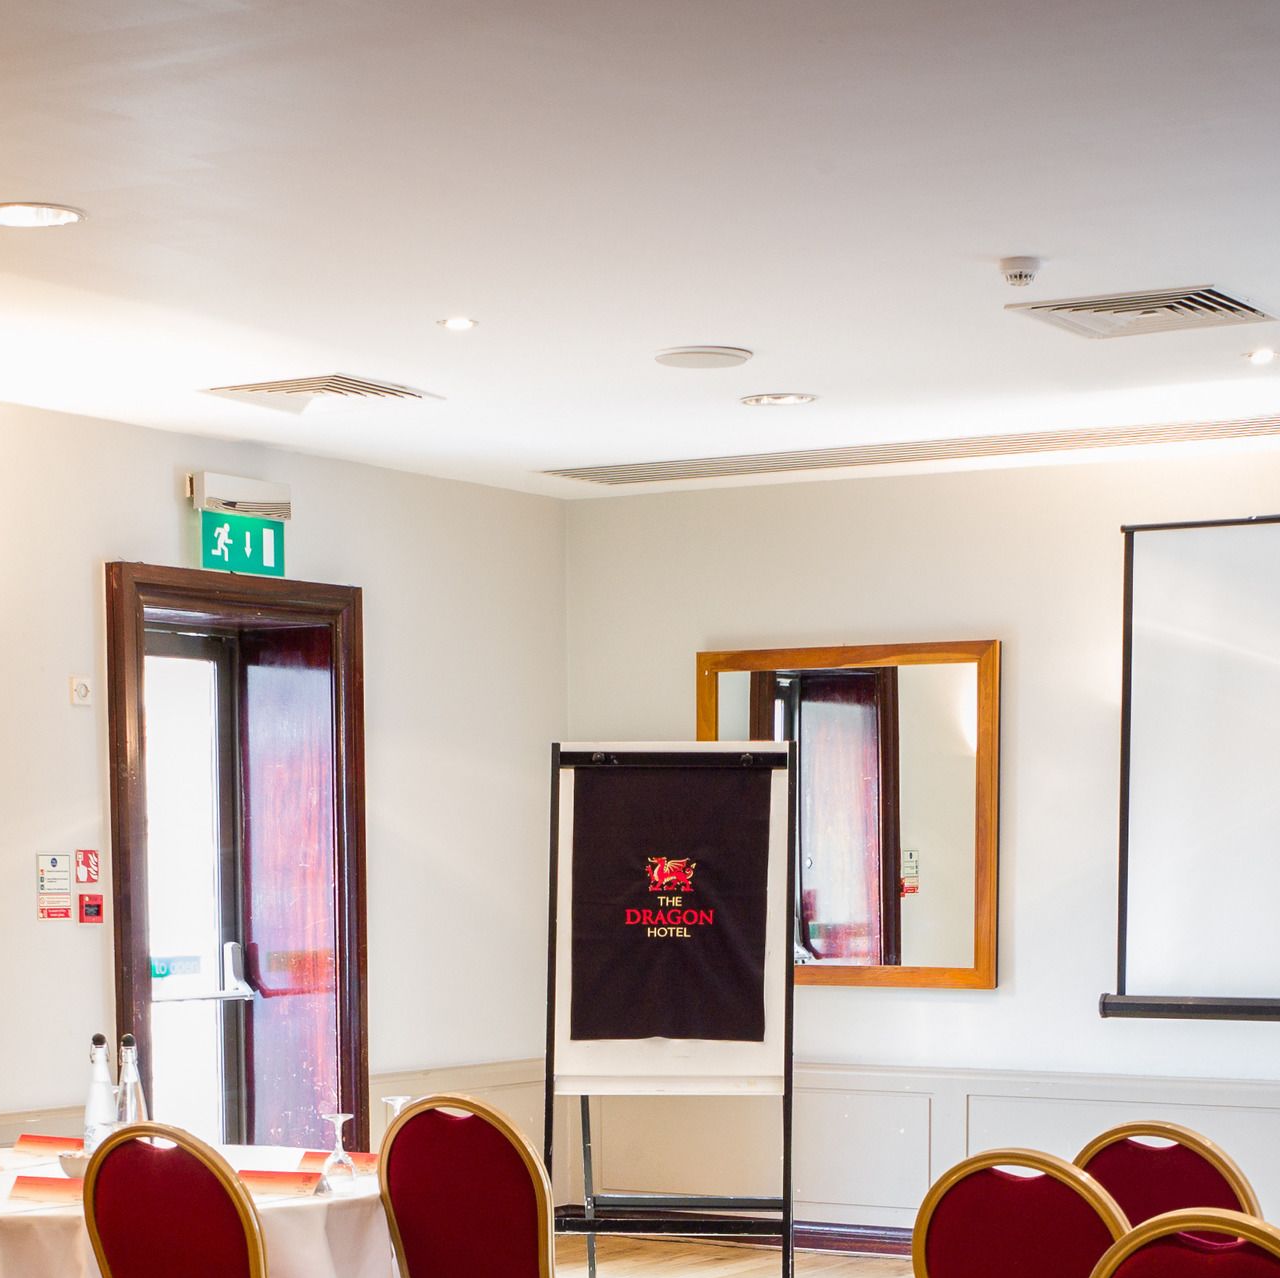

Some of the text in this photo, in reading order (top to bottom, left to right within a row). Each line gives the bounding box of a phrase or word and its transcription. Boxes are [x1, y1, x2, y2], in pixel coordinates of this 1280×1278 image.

[657, 896, 683, 907] THE
[624, 908, 715, 925] DRAGON
[647, 927, 691, 938] HOTEL
